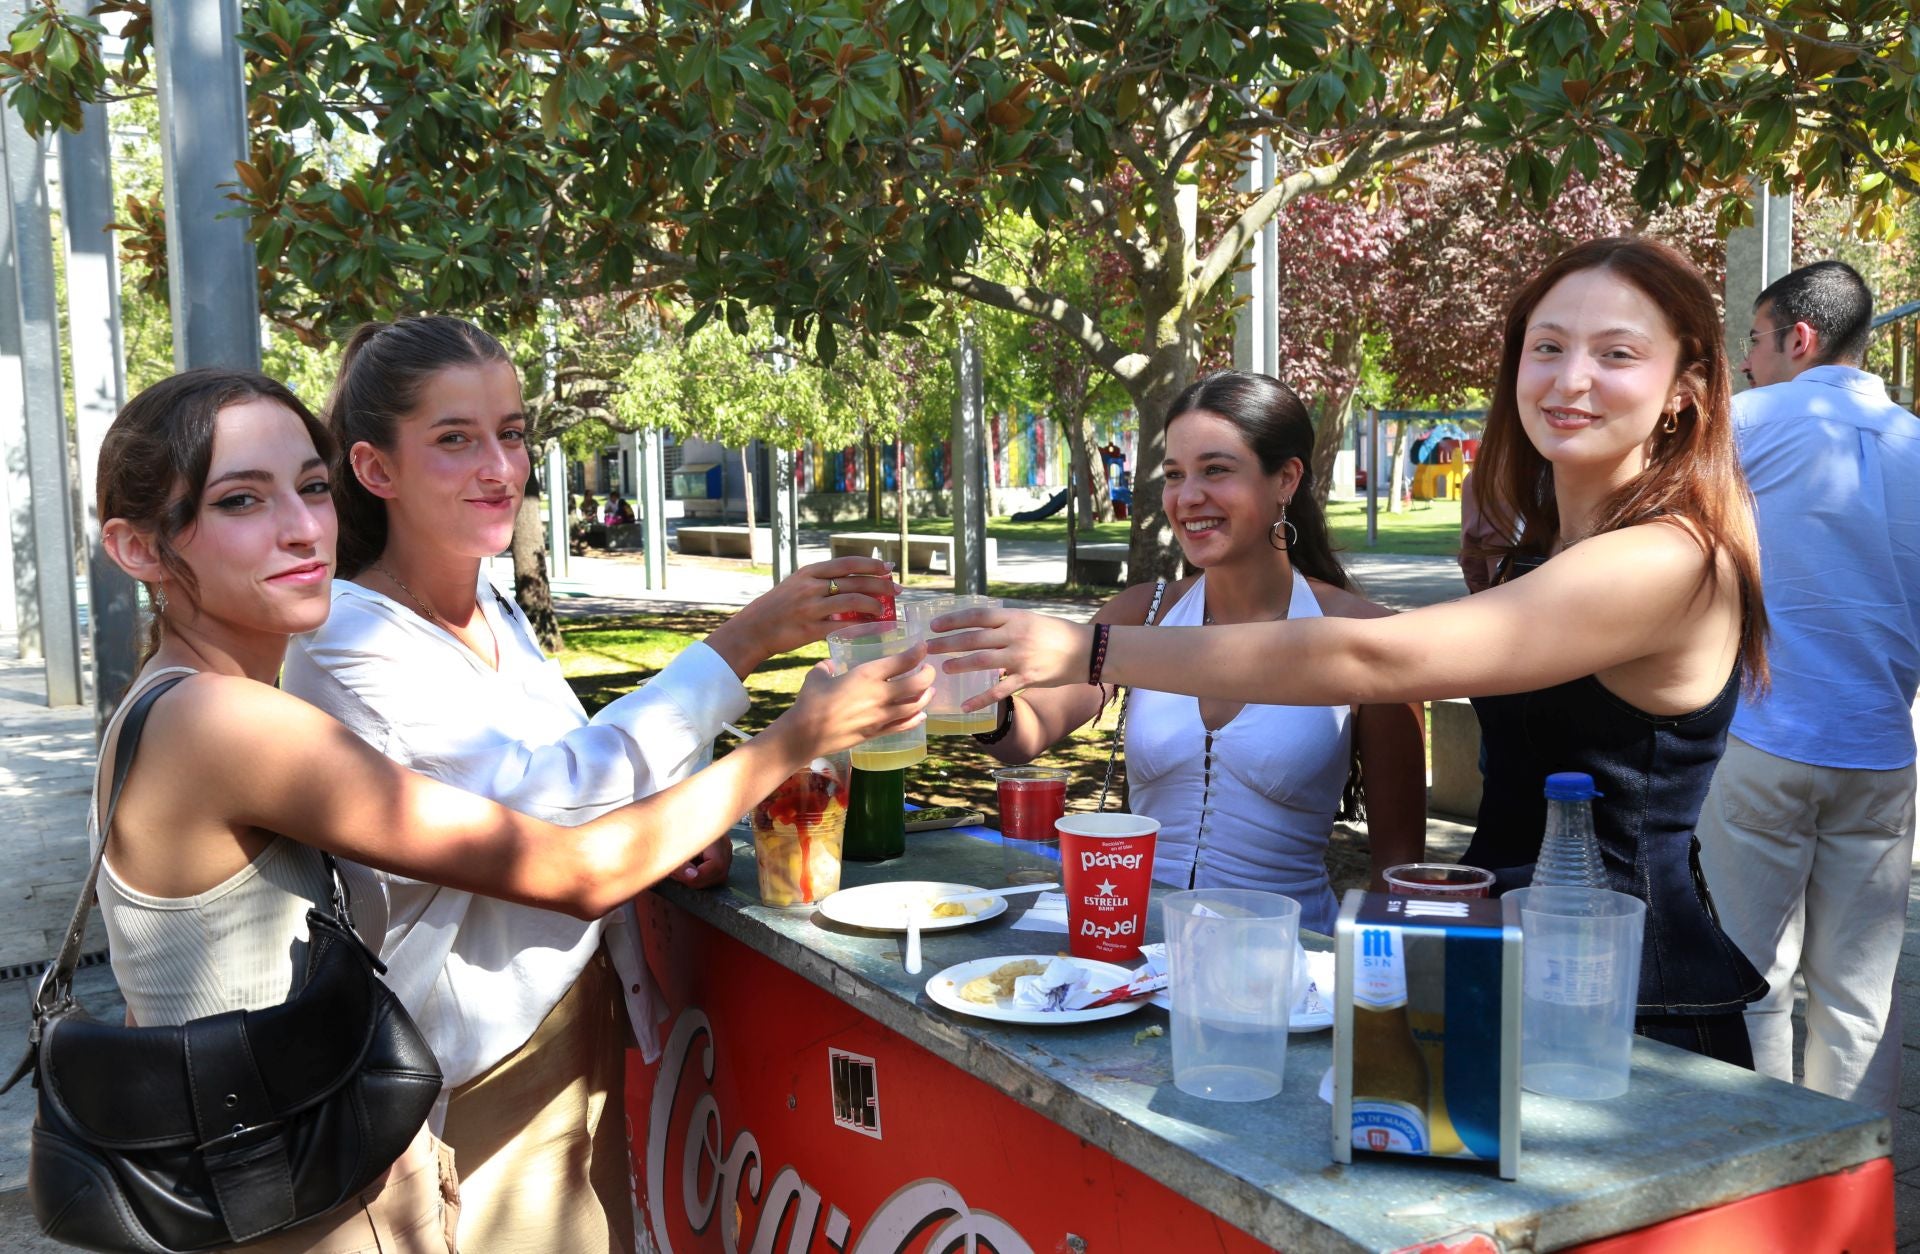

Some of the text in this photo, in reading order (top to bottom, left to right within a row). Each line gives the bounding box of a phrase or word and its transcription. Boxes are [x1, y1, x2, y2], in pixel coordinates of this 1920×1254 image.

[1081, 851, 1143, 871] paper
[1084, 896, 1129, 907] ESTRELLA
[1081, 914, 1137, 939] papel
[1364, 959, 1391, 967] SIN
